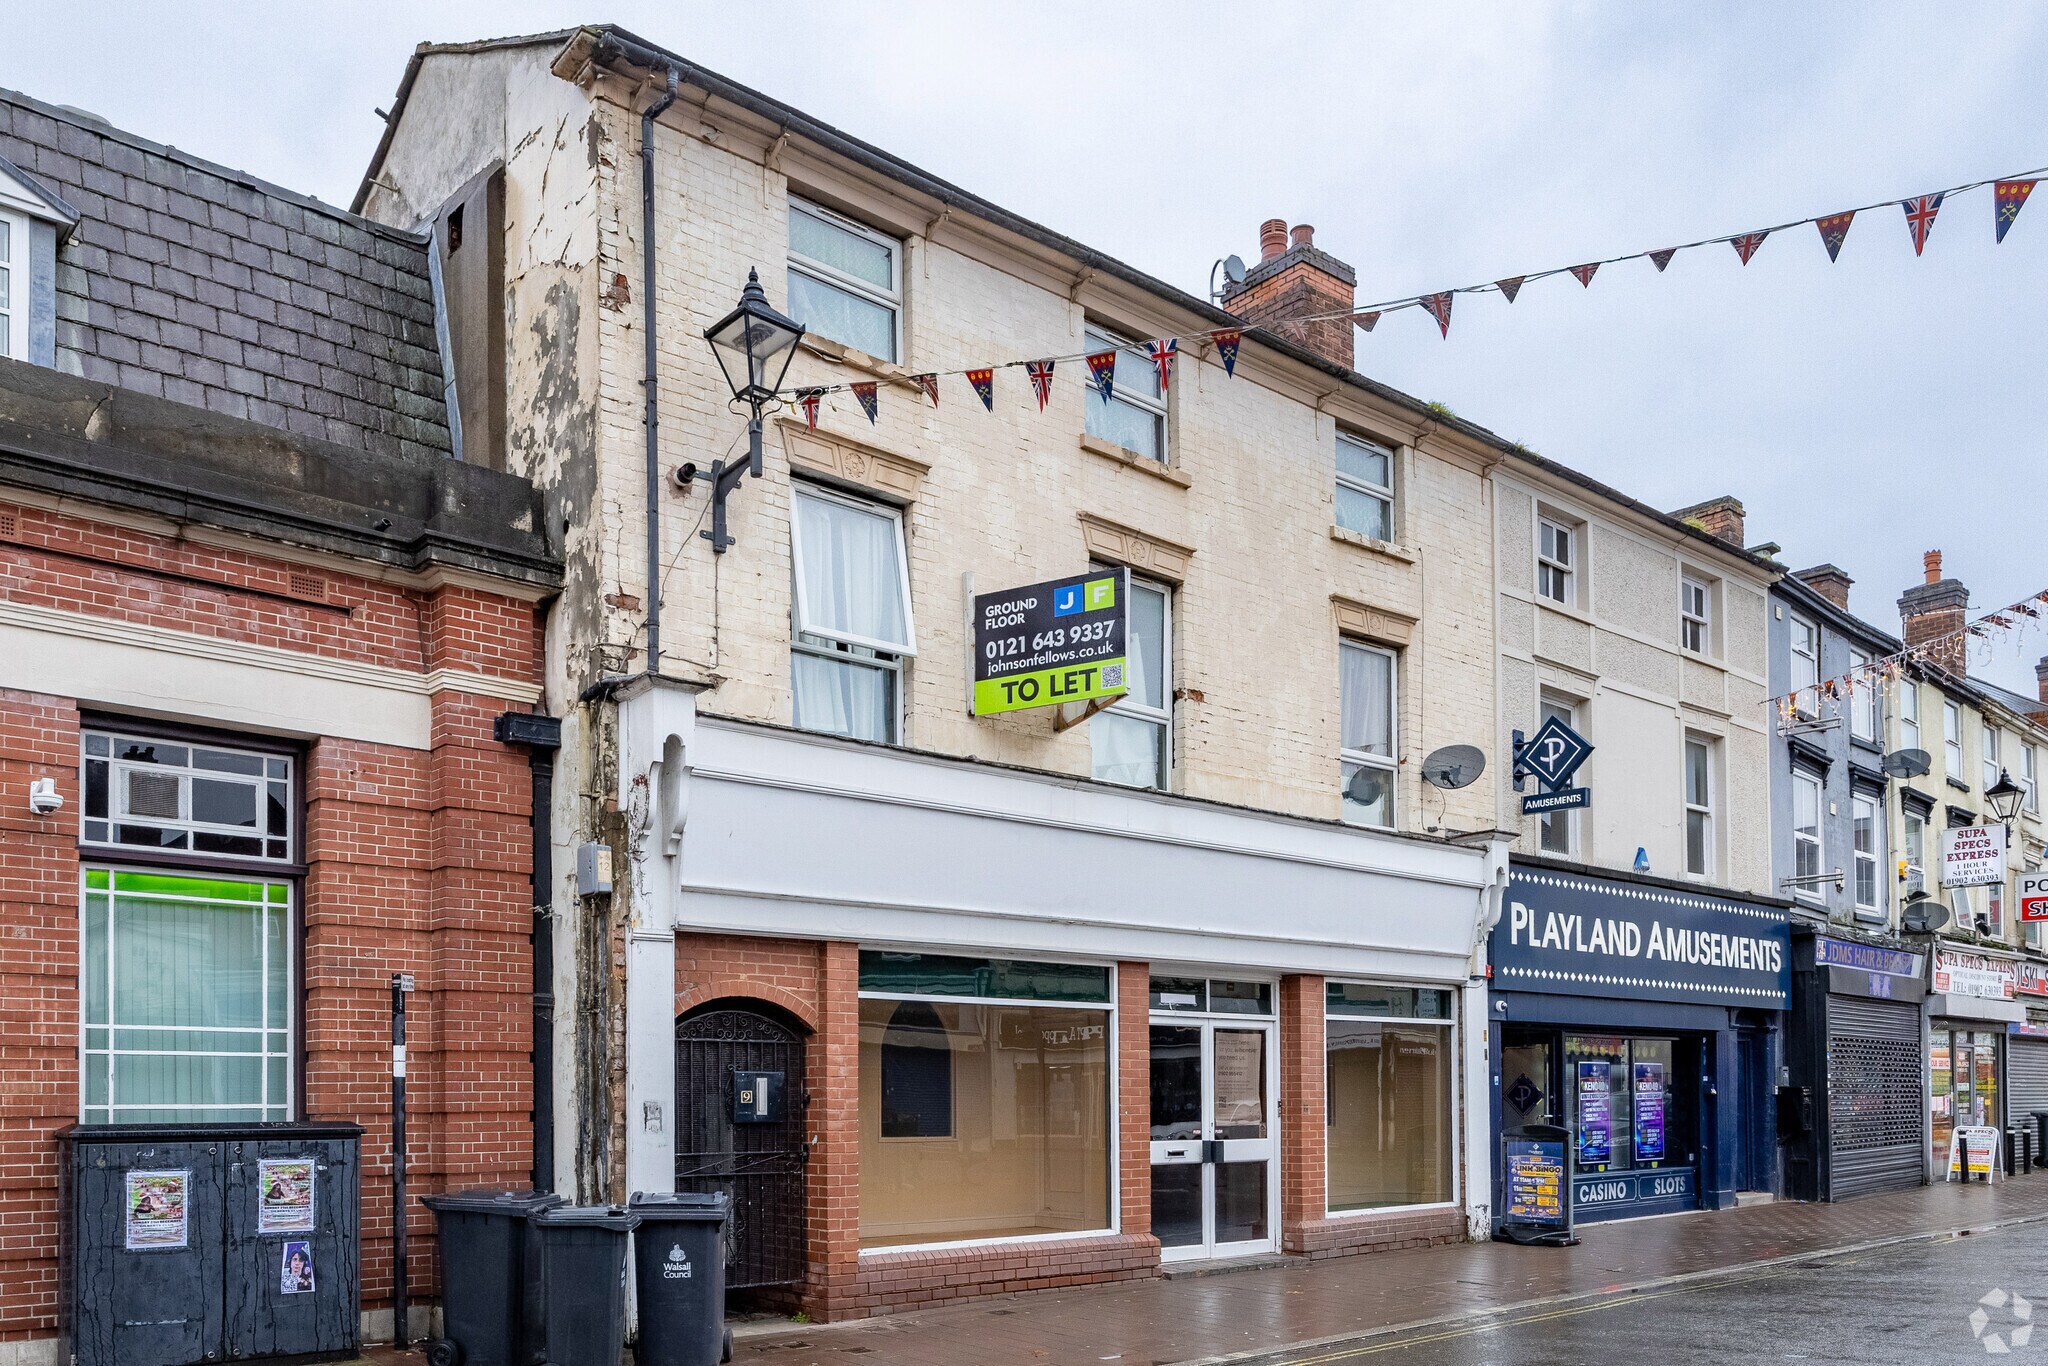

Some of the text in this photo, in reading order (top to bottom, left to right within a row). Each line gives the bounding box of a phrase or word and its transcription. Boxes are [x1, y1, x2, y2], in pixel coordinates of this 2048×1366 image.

[985, 597, 1038, 618] GROUND
[985, 613, 1026, 630] FLOOR
[985, 619, 1115, 659] 0121 643 9337
[987, 641, 1114, 676] johnsonfellows.co.uk
[1001, 667, 1098, 704] TO LET
[1525, 793, 1582, 810] AMUSEMENTS
[1957, 828, 1988, 839] SUPA
[1954, 838, 1991, 851] SPECS
[1946, 849, 1999, 862] EXPRESS
[1952, 867, 1994, 877] SERVICES
[1963, 861, 1988, 869] HOUR
[1946, 873, 1999, 885] 01902 630393
[1828, 943, 1852, 964] JDMS
[1854, 947, 1875, 967] HAIR
[1876, 951, 1883, 967] &
[1936, 950, 2015, 980] SUPA SPECS EXPRESS
[1953, 981, 1966, 993] TEL:
[743, 1092, 750, 1102] 9
[1579, 1181, 1627, 1202] CASINO
[1654, 1176, 1686, 1195] SLOTS
[663, 1262, 691, 1271] Walsall
[663, 1270, 692, 1279] Council
